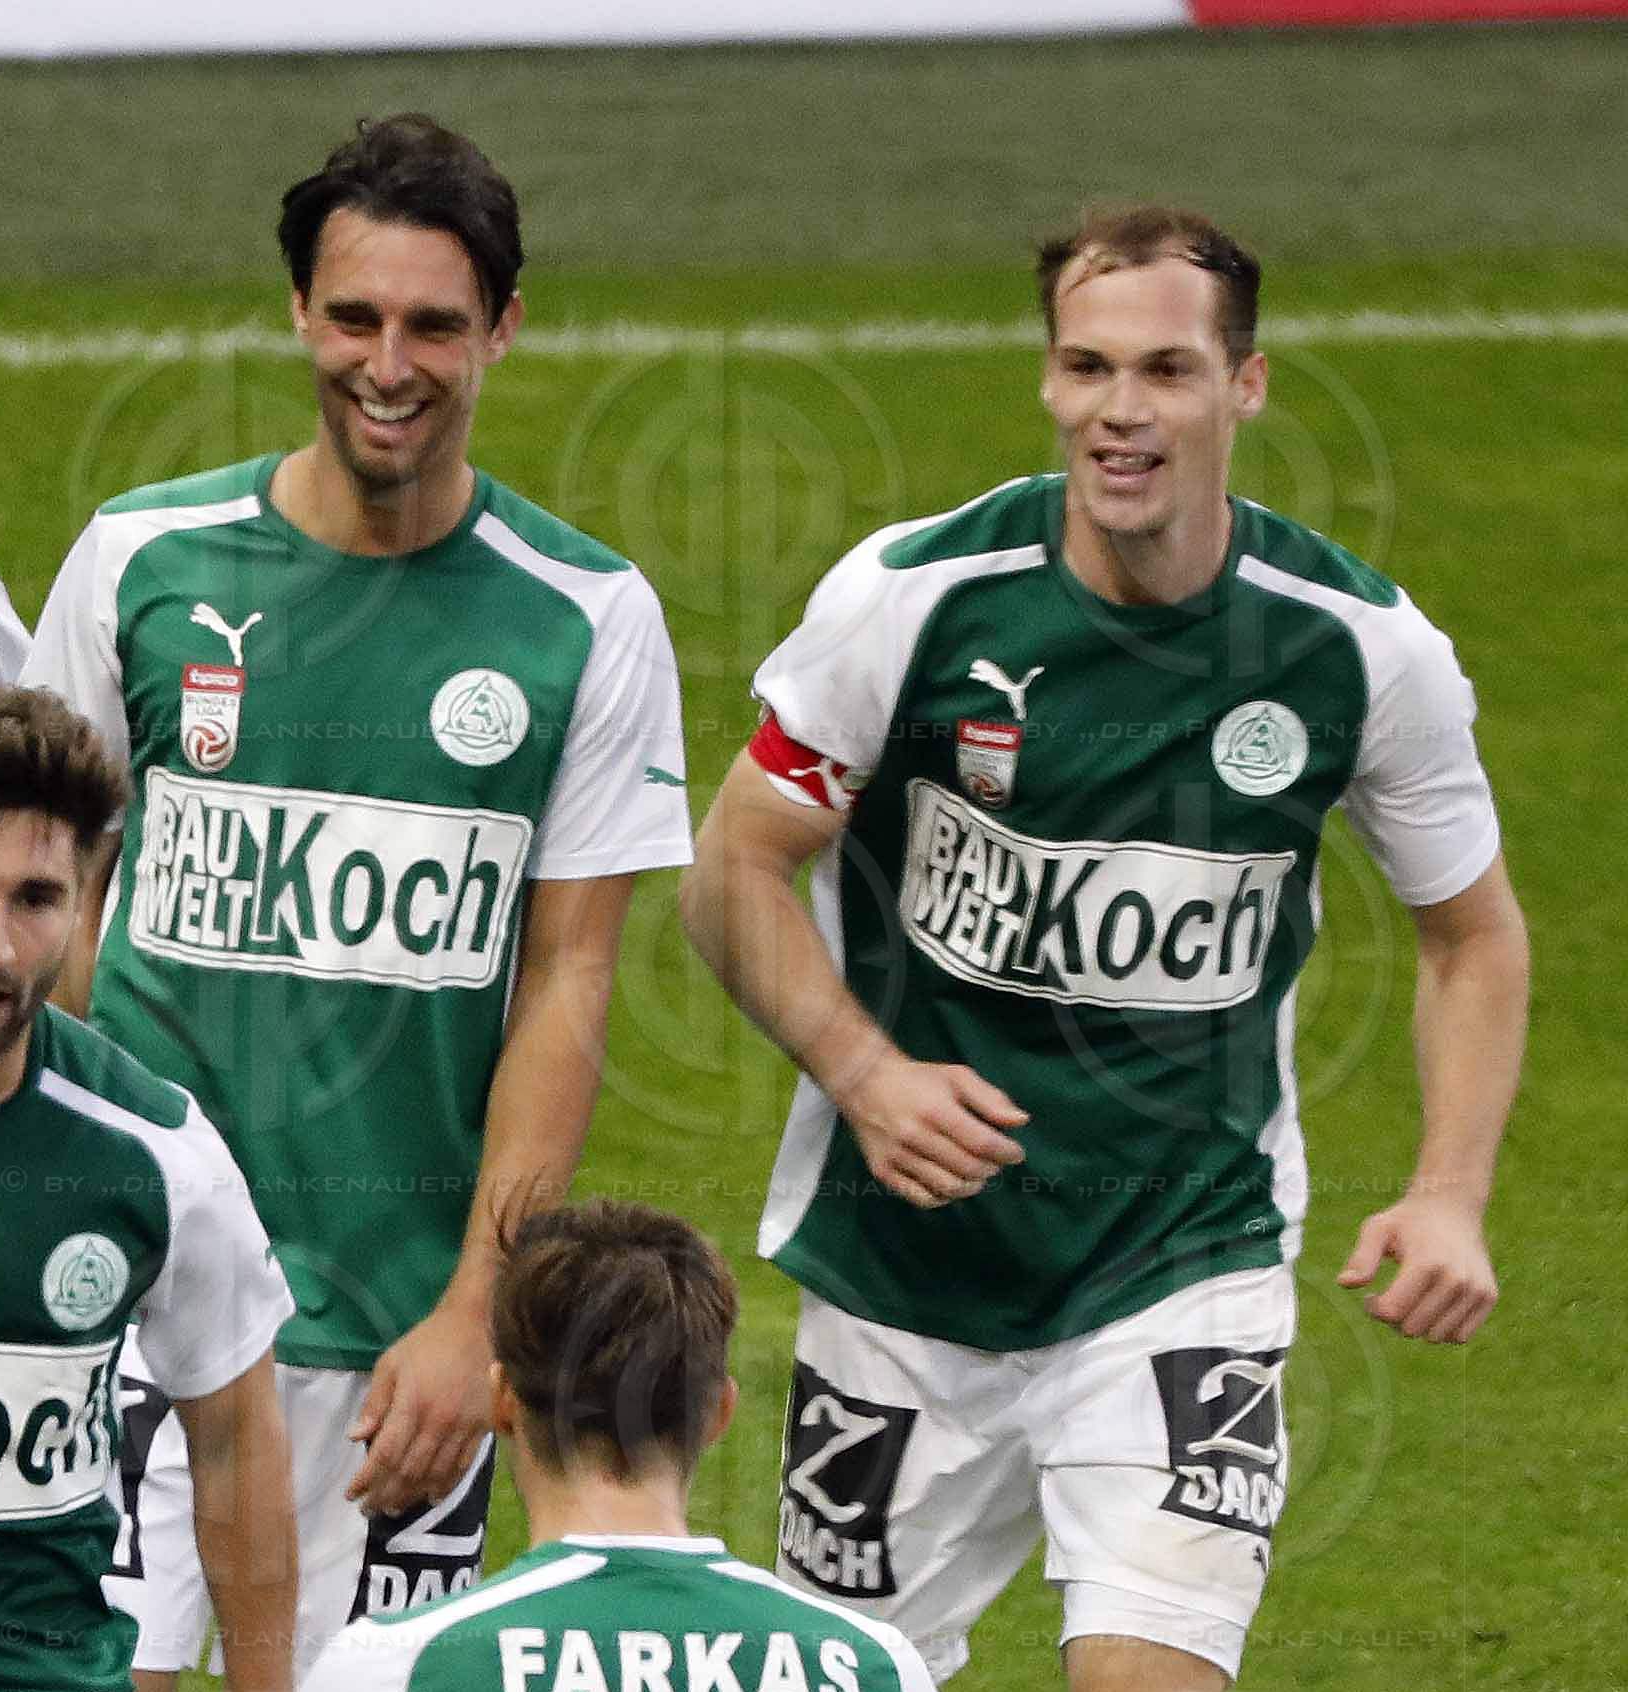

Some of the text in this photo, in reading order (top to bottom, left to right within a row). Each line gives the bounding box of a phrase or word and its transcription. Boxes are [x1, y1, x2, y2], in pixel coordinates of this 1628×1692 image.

[156, 793, 243, 877] BAU
[259, 807, 502, 959] Koch
[930, 809, 1019, 905] BAU
[147, 861, 253, 949] WELT
[916, 871, 1022, 974] WELT
[1022, 856, 1265, 990] Koch
